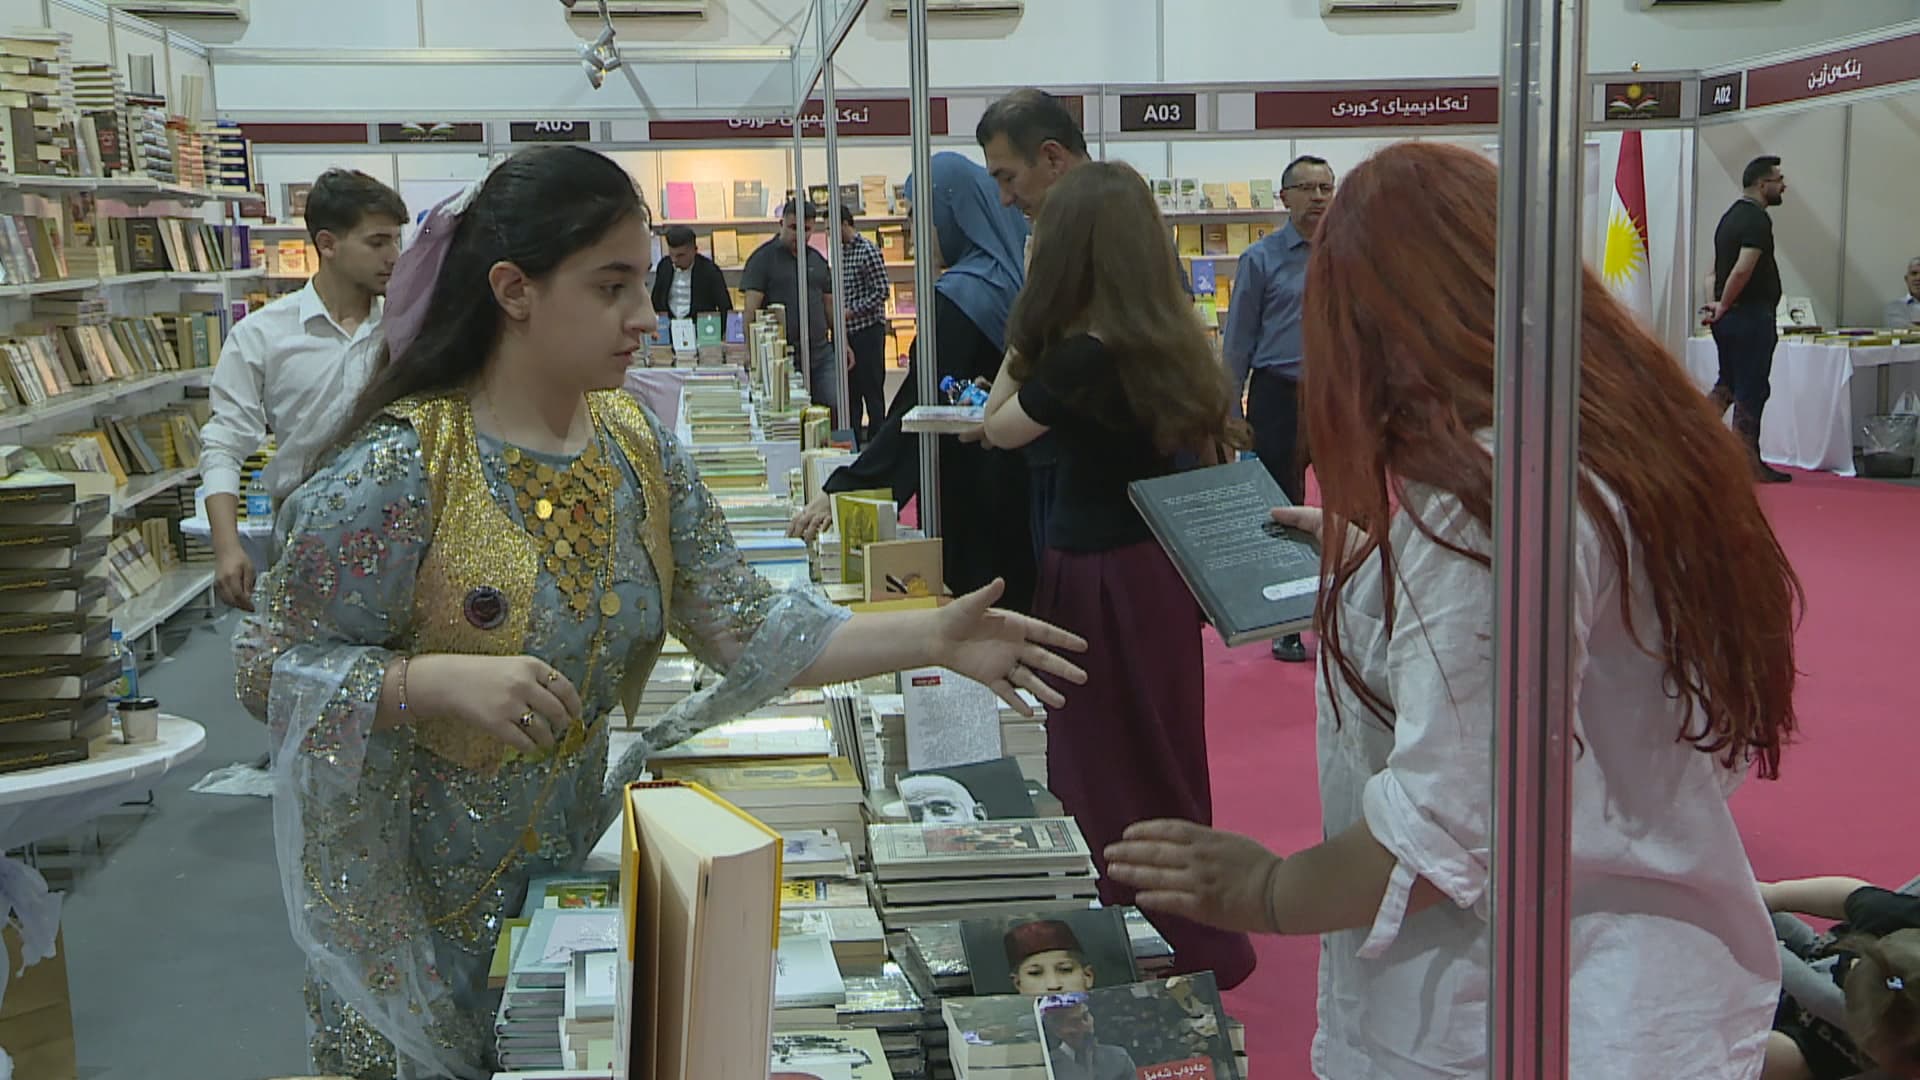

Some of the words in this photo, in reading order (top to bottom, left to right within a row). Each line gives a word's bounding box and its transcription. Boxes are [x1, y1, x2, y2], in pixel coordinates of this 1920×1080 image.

[1713, 86, 1732, 104] A02
[1143, 104, 1181, 121] A03
[1331, 98, 1380, 117] کوردی
